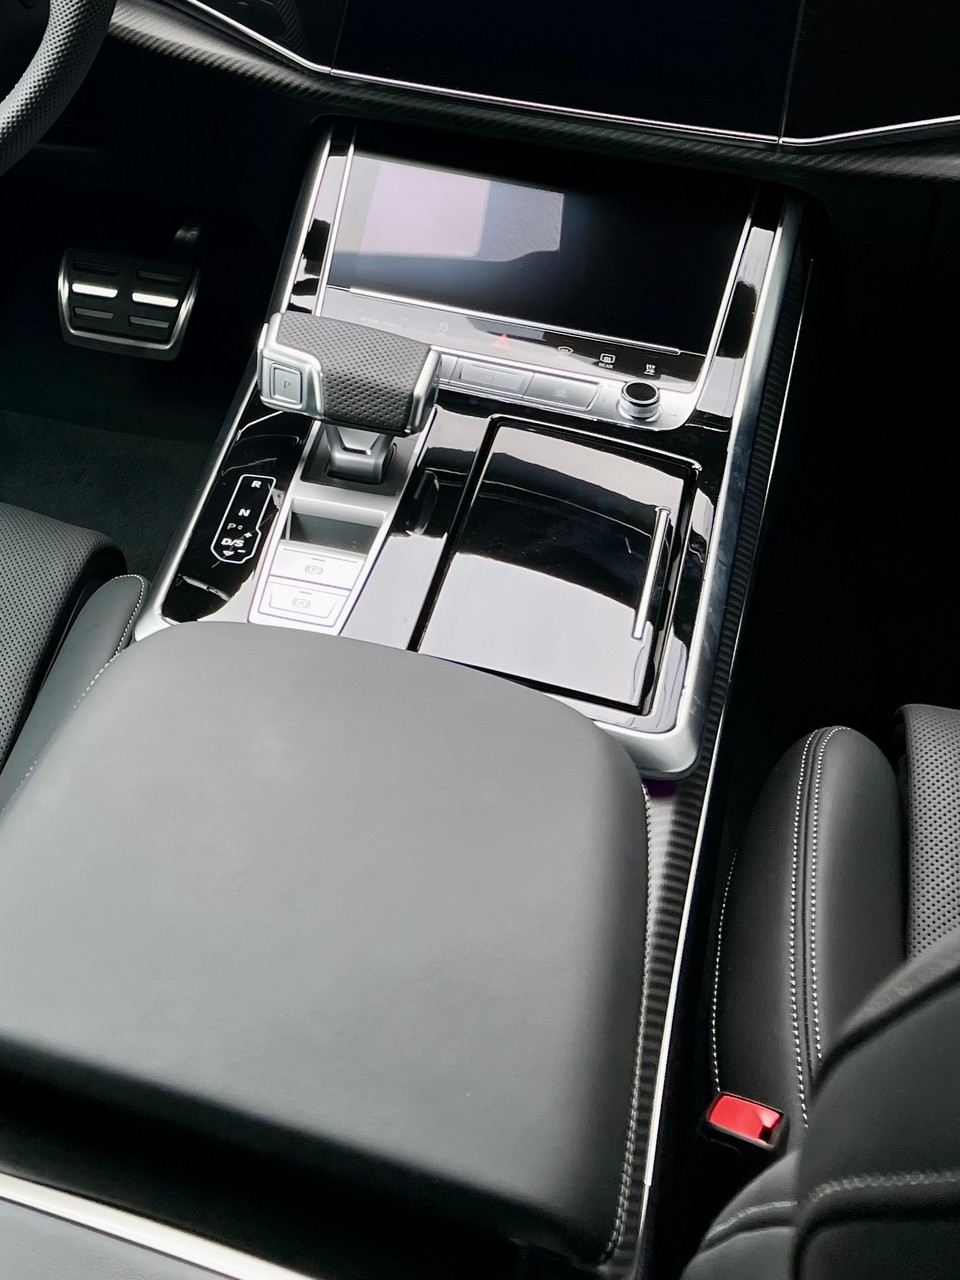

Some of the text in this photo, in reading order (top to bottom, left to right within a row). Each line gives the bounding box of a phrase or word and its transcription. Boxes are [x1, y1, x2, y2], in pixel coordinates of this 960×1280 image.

[283, 380, 291, 389] P
[251, 480, 262, 488] R
[238, 509, 250, 517] N
[221, 537, 245, 547] D/S
